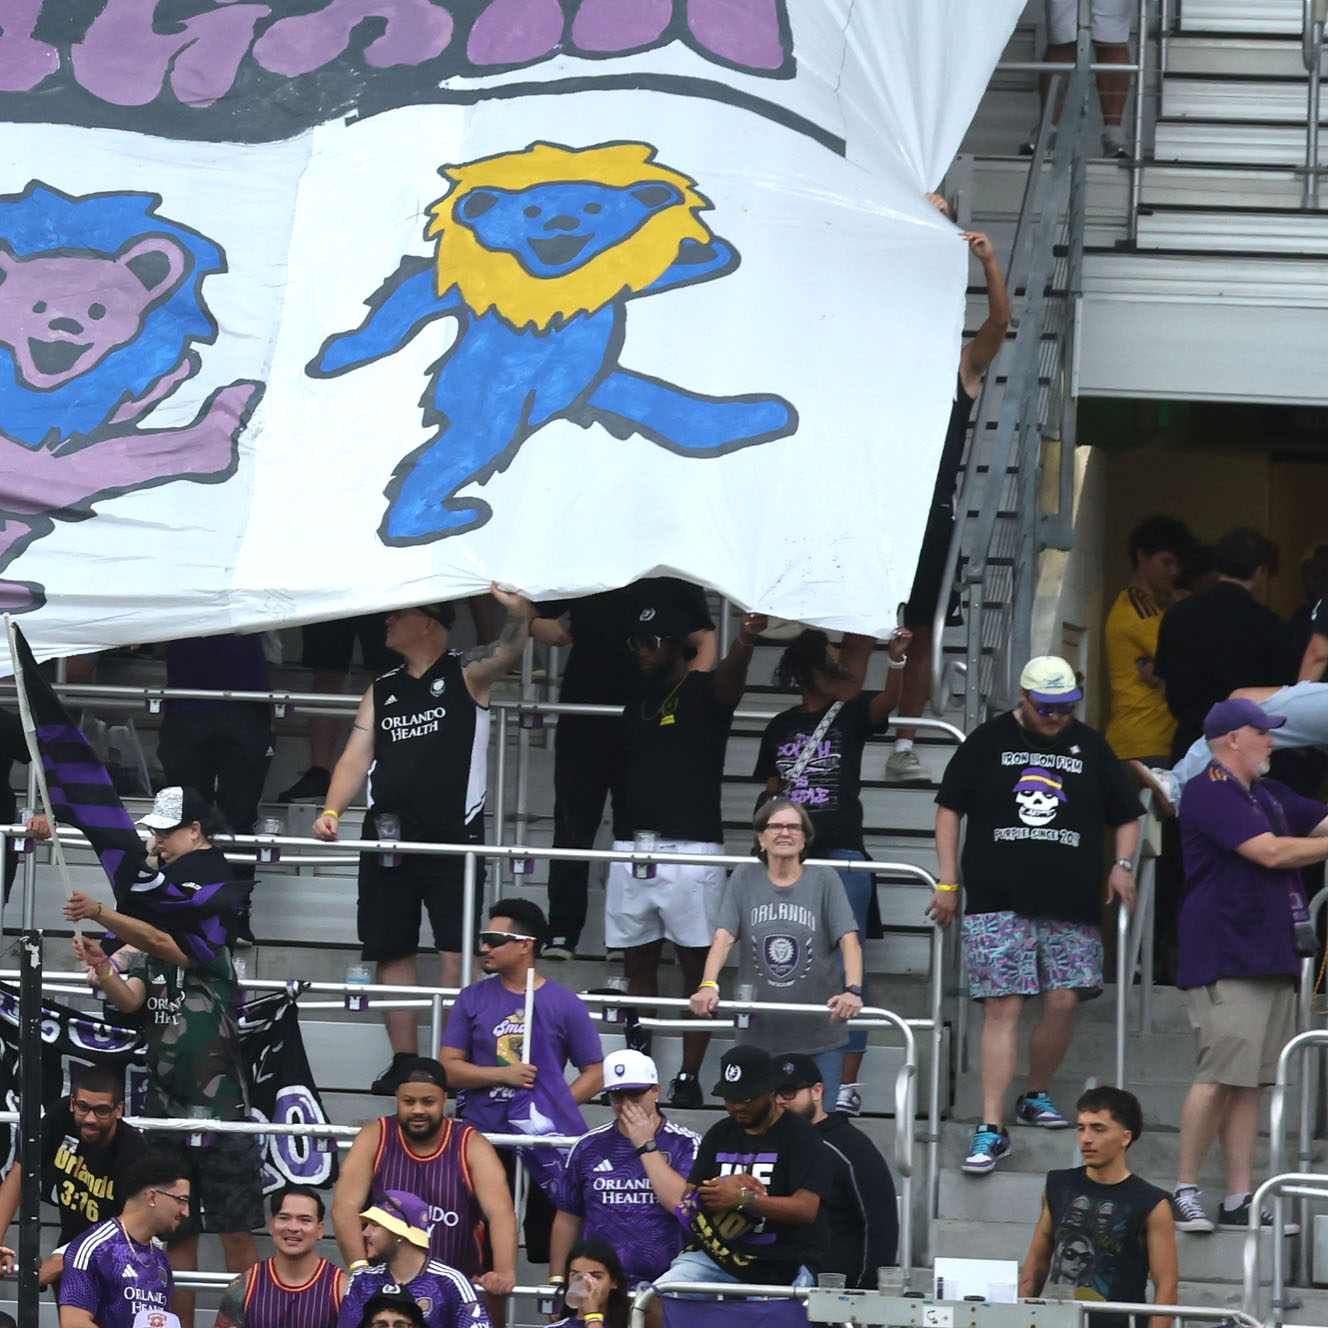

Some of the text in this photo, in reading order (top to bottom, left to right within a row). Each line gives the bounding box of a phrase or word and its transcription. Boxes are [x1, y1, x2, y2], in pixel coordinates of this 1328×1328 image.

[381, 706, 446, 730] ORLANDO
[391, 720, 439, 743] HEALTH
[1001, 751, 1030, 766] IRON
[1056, 755, 1083, 774] FIRM
